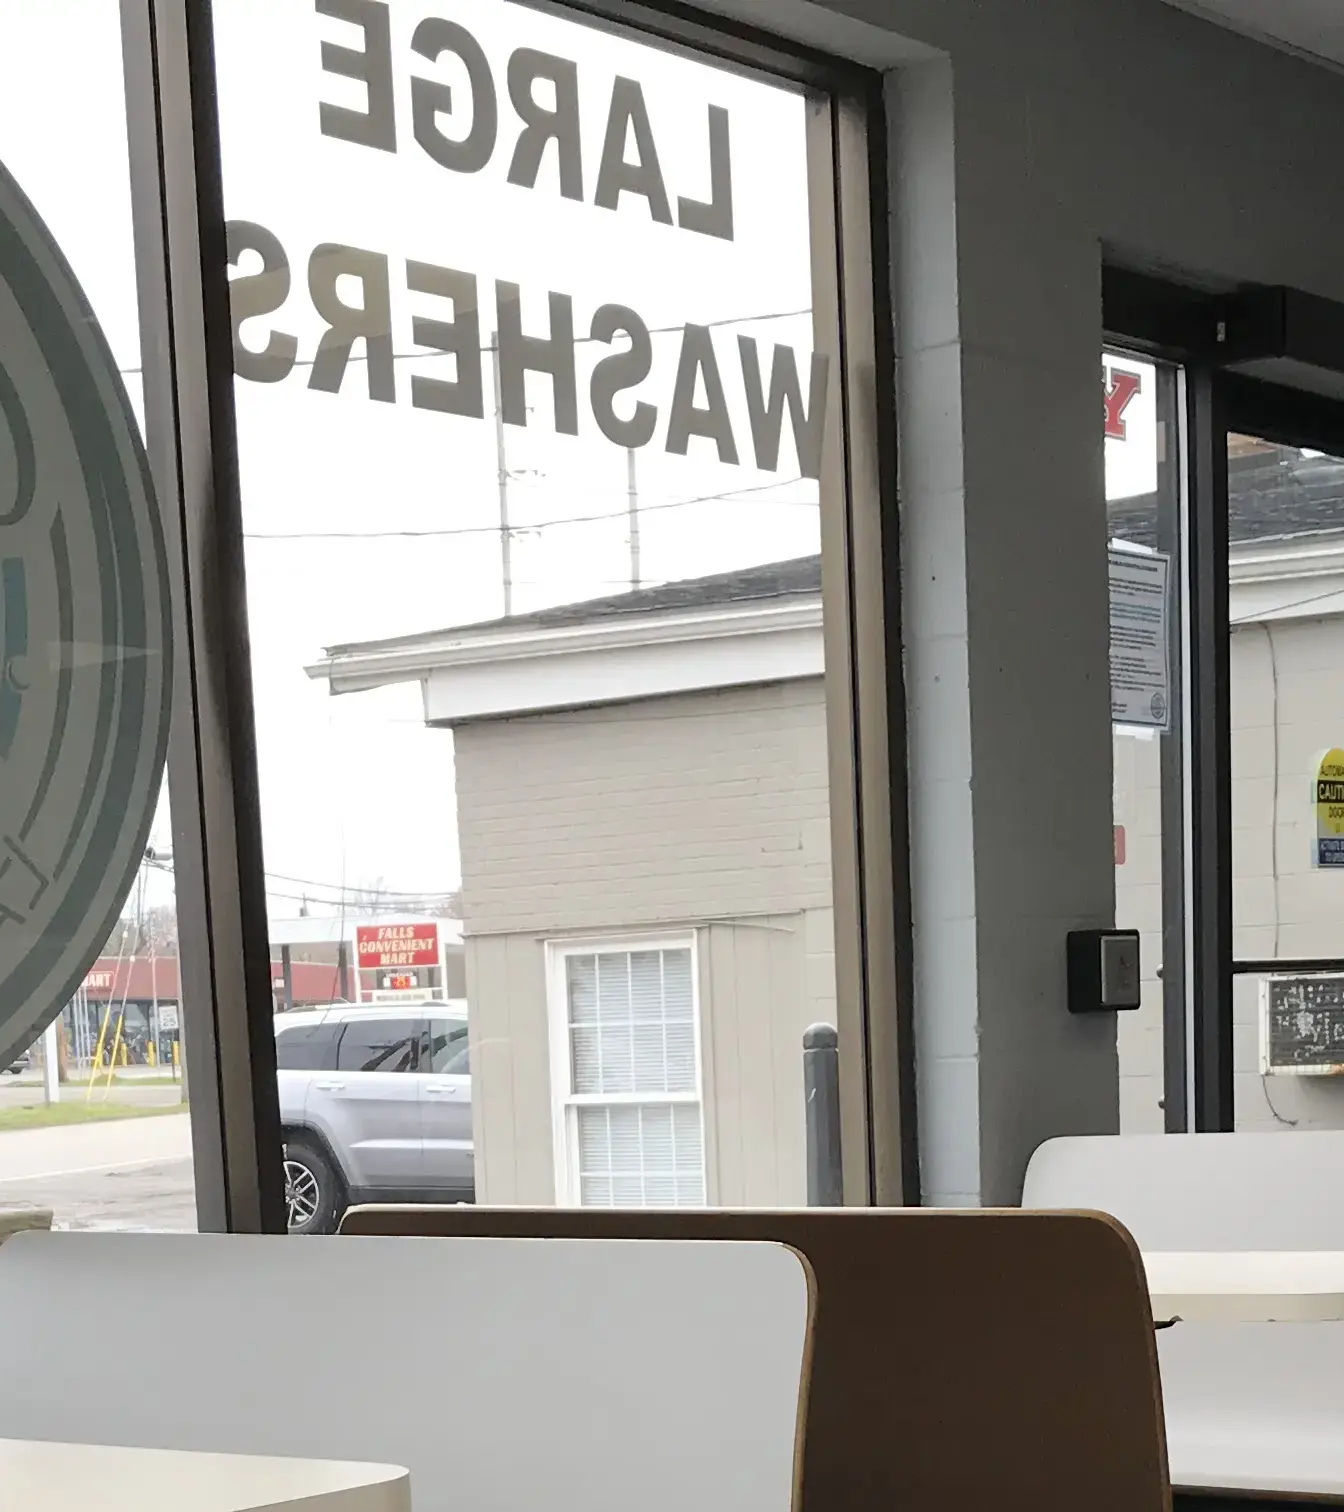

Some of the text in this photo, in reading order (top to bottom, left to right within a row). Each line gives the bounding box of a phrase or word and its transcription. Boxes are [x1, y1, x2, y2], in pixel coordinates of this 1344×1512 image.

[377, 926, 415, 940] FALLS
[359, 938, 435, 954] CONVENIENT
[379, 952, 416, 965] MART
